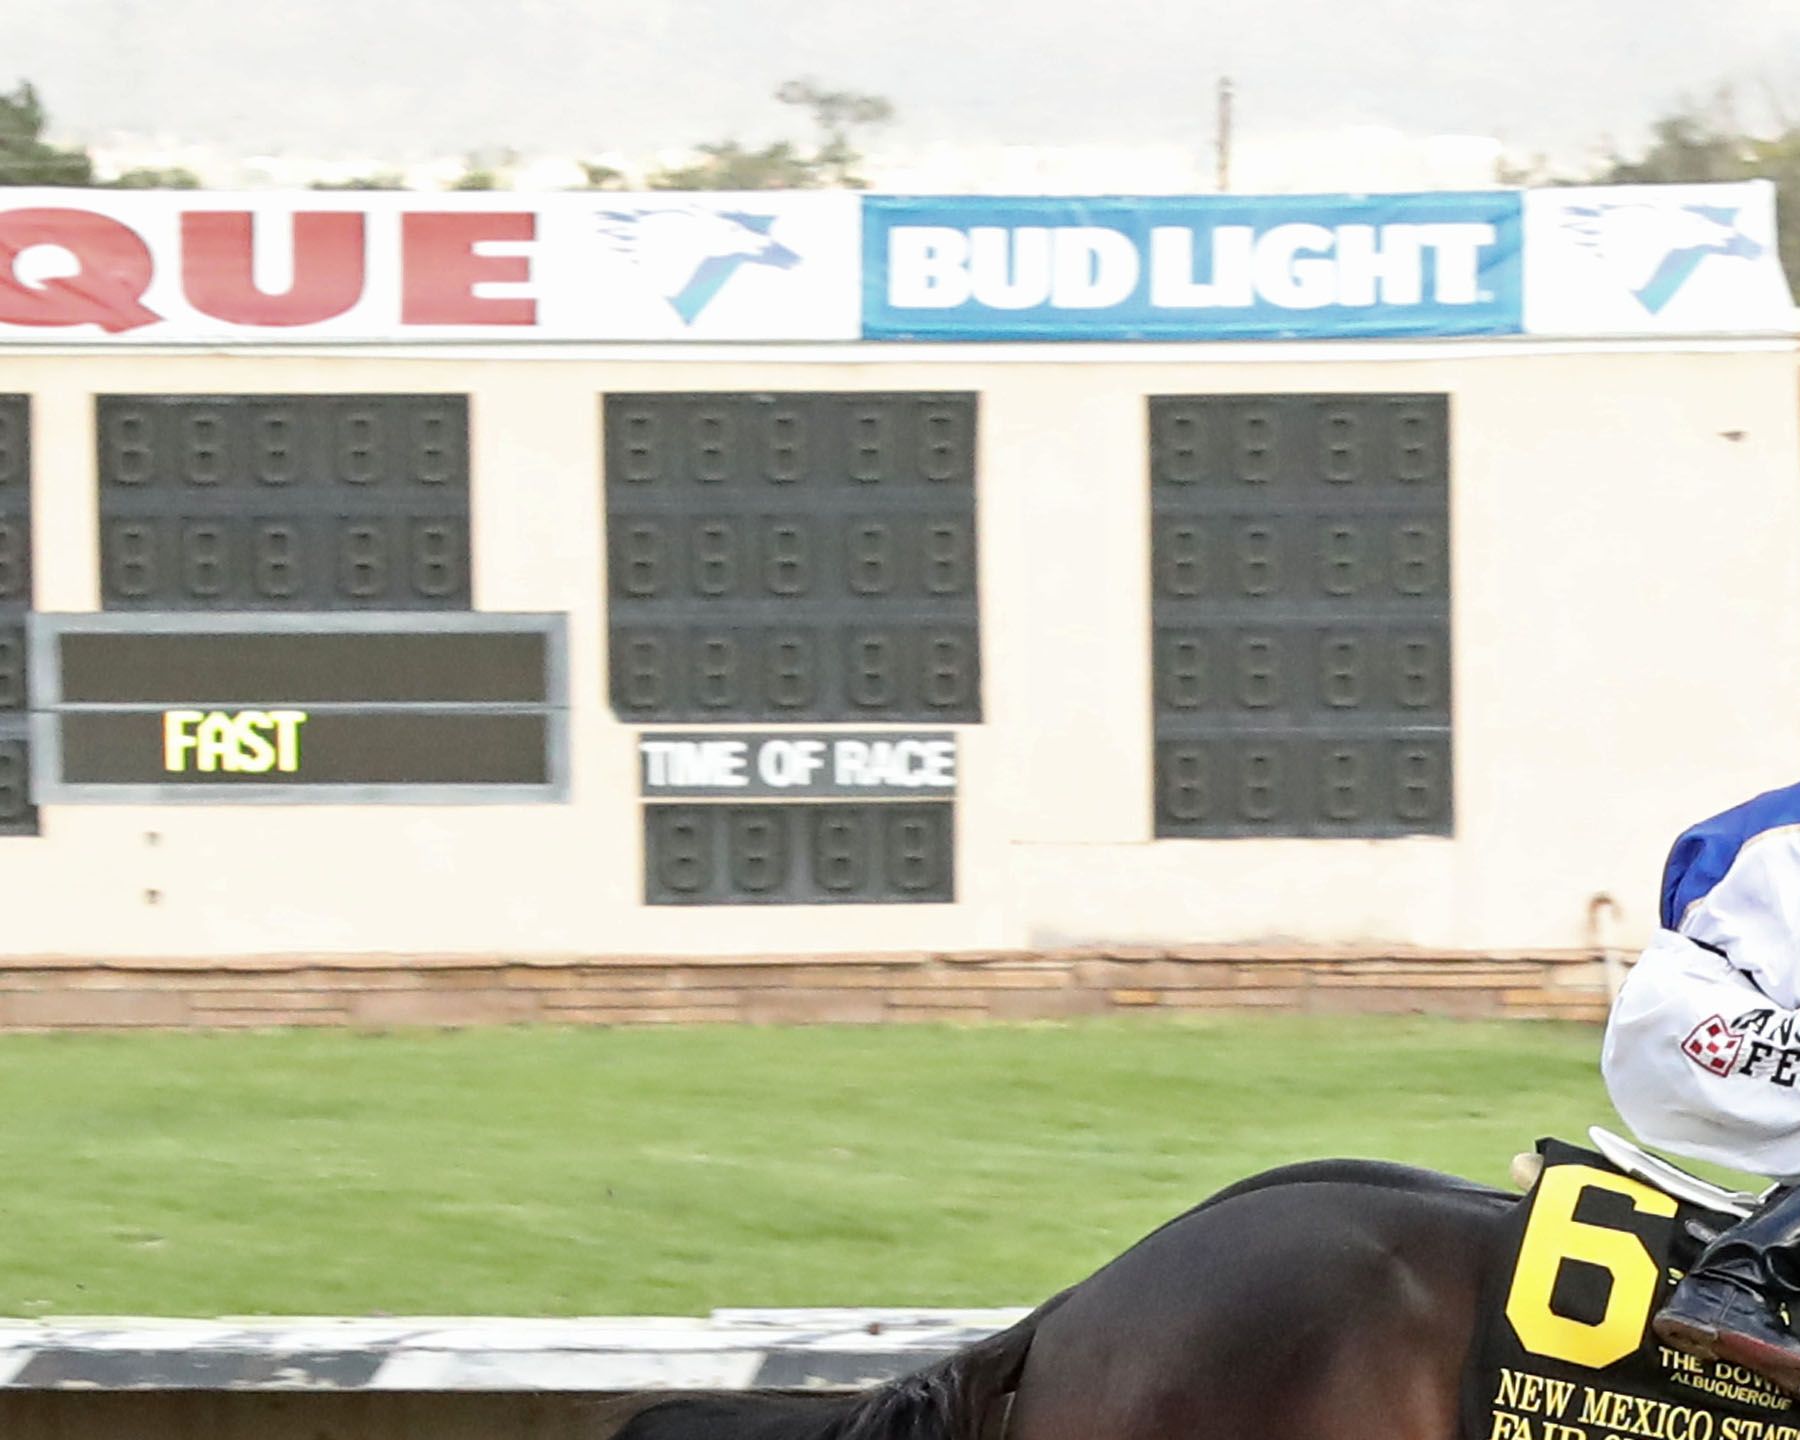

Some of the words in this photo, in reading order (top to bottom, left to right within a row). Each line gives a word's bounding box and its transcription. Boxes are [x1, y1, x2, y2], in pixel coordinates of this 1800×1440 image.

[888, 225, 1140, 309] BUD
[1150, 223, 1498, 309] LIGHT
[163, 710, 309, 774] FAST
[639, 740, 748, 787] TIME
[757, 739, 827, 787] OF
[834, 739, 957, 787] RACE
[1505, 1163, 1679, 1370] 6
[1494, 1367, 1576, 1419] NEW
[1657, 1345, 1704, 1374] THE
[1714, 1362, 1790, 1396] DOW
[1670, 1371, 1792, 1411] ALBUQUERQUE
